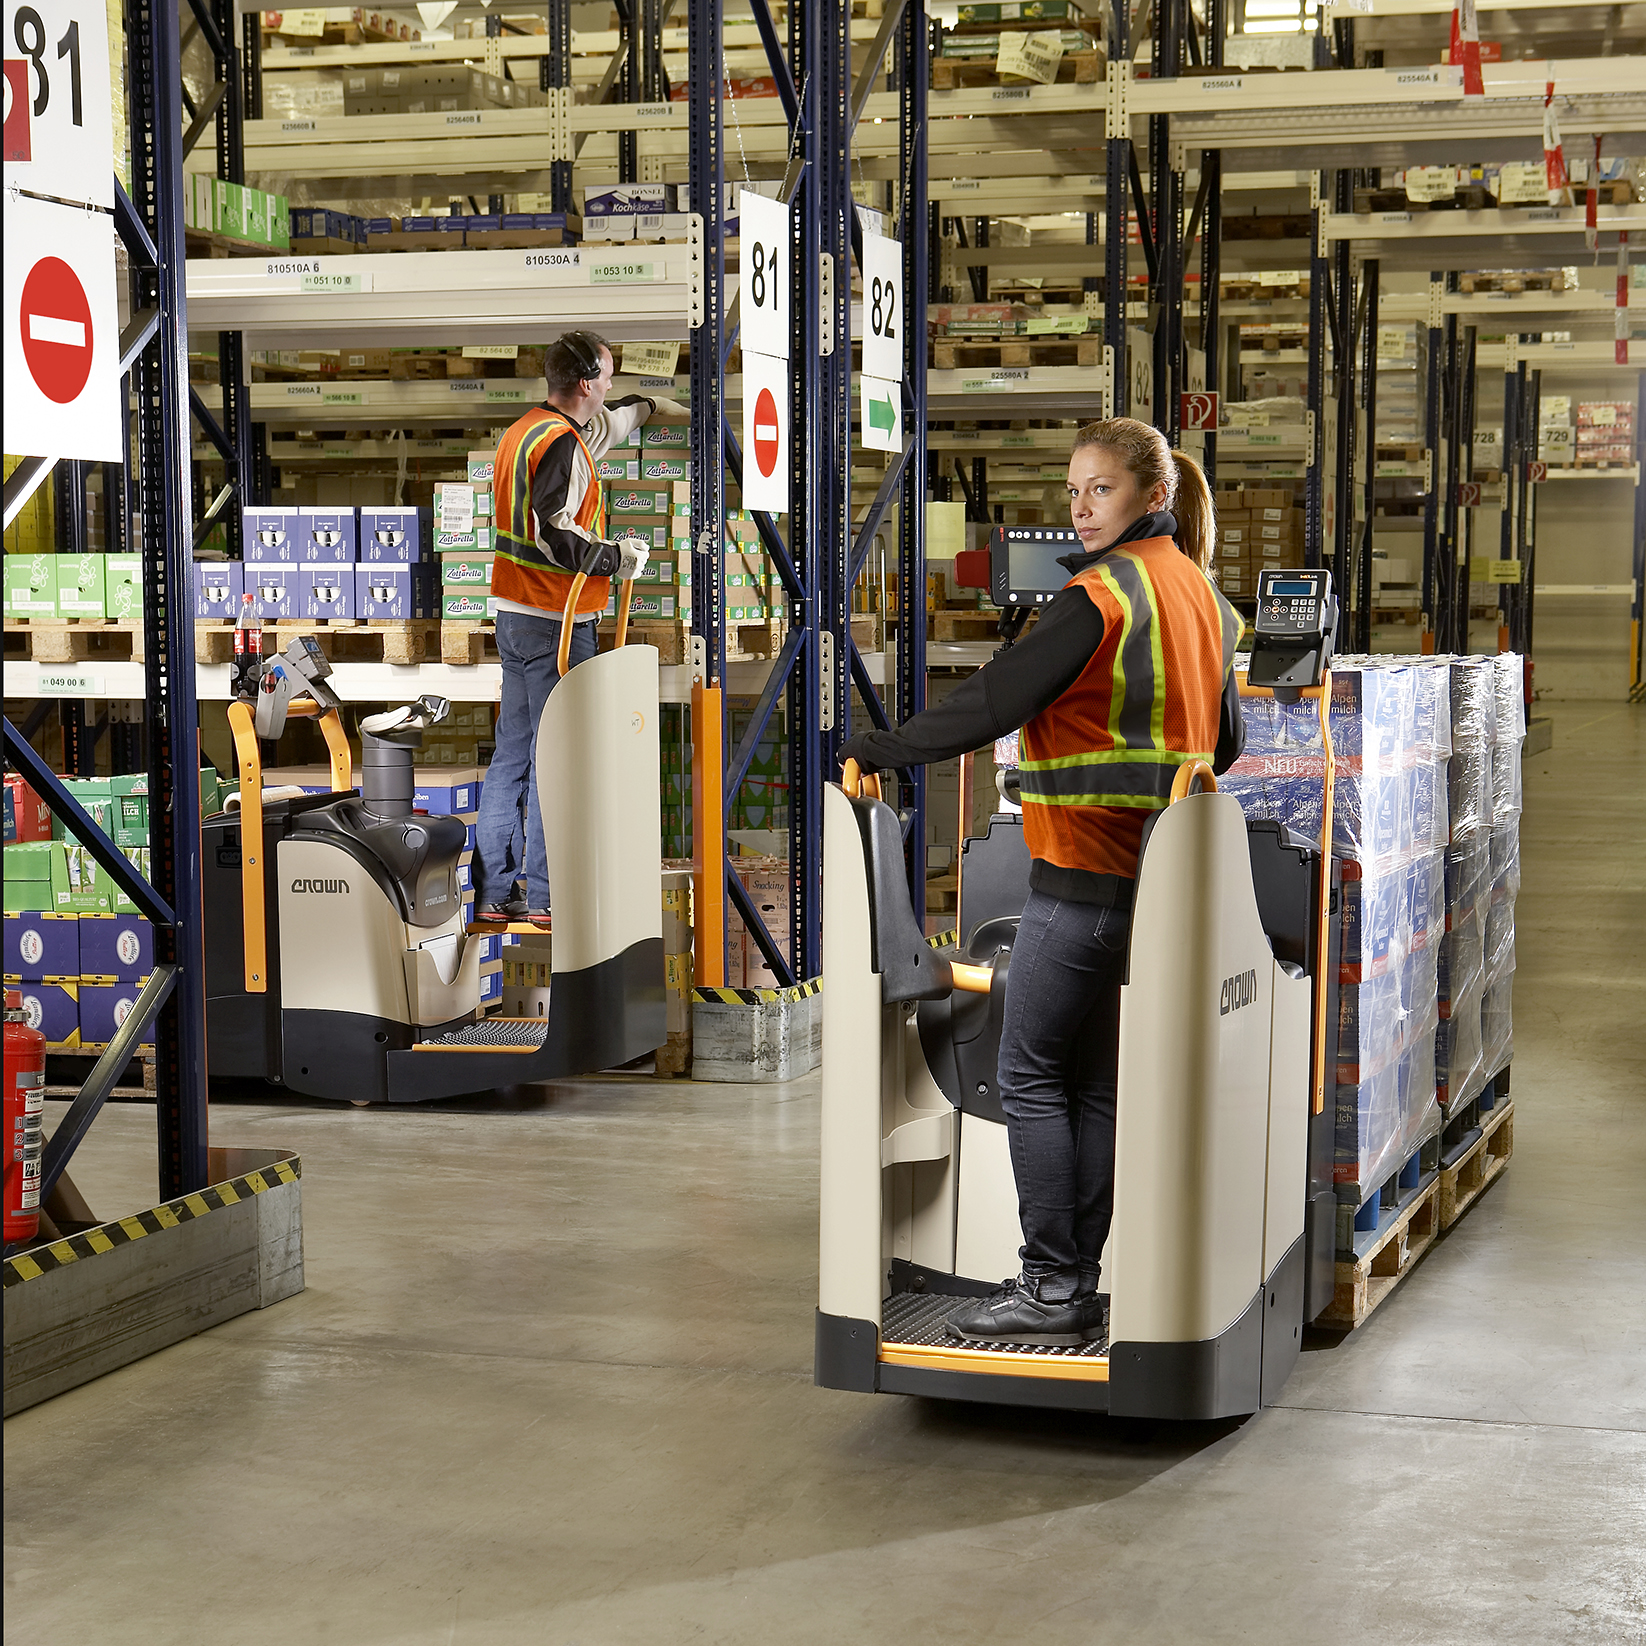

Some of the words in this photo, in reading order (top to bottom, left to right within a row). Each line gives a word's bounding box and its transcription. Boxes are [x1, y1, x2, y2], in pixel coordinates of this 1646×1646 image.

[14, 6, 83, 127] 81
[612, 202, 650, 213] Kochkäse
[525, 255, 571, 265] 810530A
[573, 254, 580, 264] 4
[267, 263, 310, 274] 810510A
[313, 262, 320, 273] 6
[603, 266, 620, 276] 053
[623, 266, 634, 275] 10
[313, 276, 329, 285] 051
[332, 276, 342, 285] 10
[752, 241, 778, 311] 81
[871, 276, 895, 340] 82
[648, 364, 660, 372] 578
[1024, 371, 1029, 379] 2
[1136, 360, 1149, 406] 82
[647, 431, 684, 443] Zottarella
[1473, 433, 1495, 444] 728
[1546, 431, 1568, 442] 729
[645, 464, 682, 477] Zottarella
[614, 496, 652, 508] Zottarella
[438, 533, 474, 545] Zottarella
[446, 567, 482, 580] Zottarella
[447, 601, 483, 613] Zottarella
[50, 678, 65, 686] 049
[67, 678, 77, 686] 00
[80, 678, 85, 686] 6
[1331, 694, 1357, 705] Alpen
[1293, 705, 1317, 715] milch
[1331, 704, 1356, 714] milch
[1264, 756, 1297, 774] NEU
[752, 880, 785, 893] Snacking
[424, 894, 448, 907] crown.com
[17, 1117, 23, 1128] 1
[16, 1133, 24, 1144] 2
[15, 1149, 23, 1160] 3
